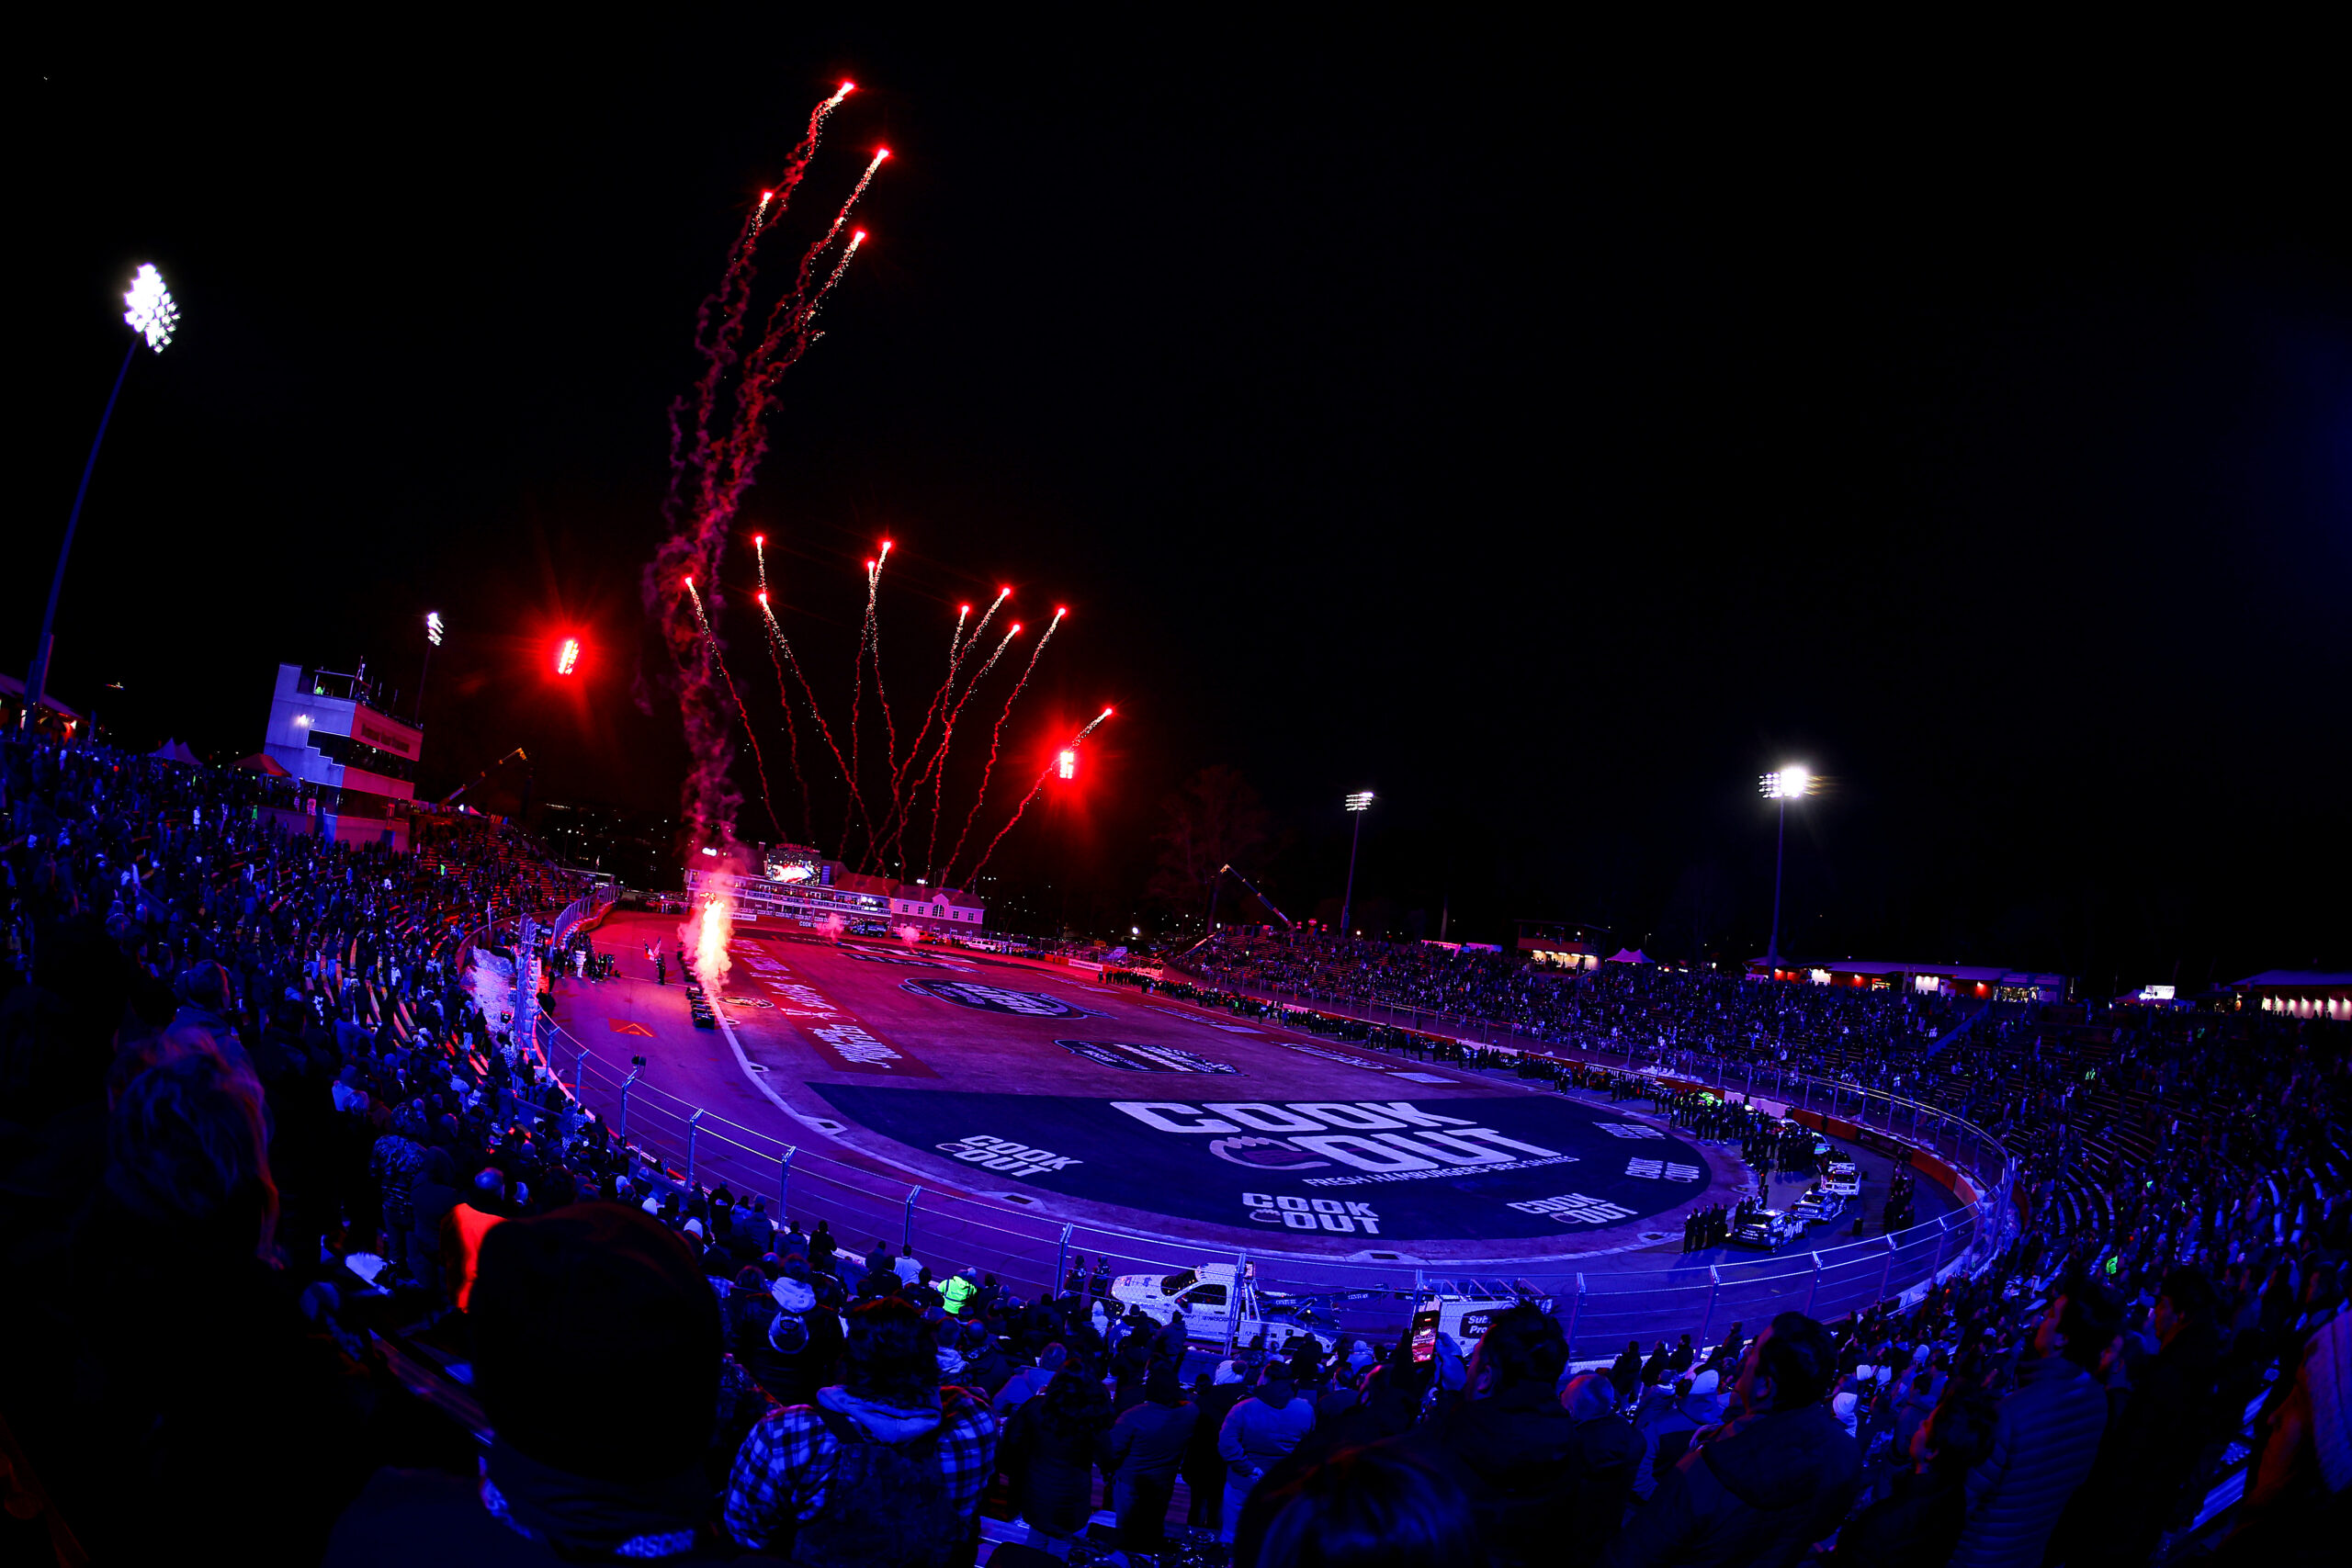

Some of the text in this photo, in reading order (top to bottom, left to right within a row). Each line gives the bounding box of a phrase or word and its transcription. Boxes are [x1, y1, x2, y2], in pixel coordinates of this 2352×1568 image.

[1110, 1101, 1478, 1134] COOK
[953, 1149, 1053, 1177] OUT
[960, 1134, 1084, 1170] COOK
[1287, 1128, 1562, 1172] OUT
[1302, 1176, 1365, 1187] FRESH
[1242, 1192, 1380, 1218] COOK
[1506, 1192, 1607, 1214] COOK
[1565, 1202, 1639, 1224] OUT
[1282, 1211, 1381, 1235] OUT
